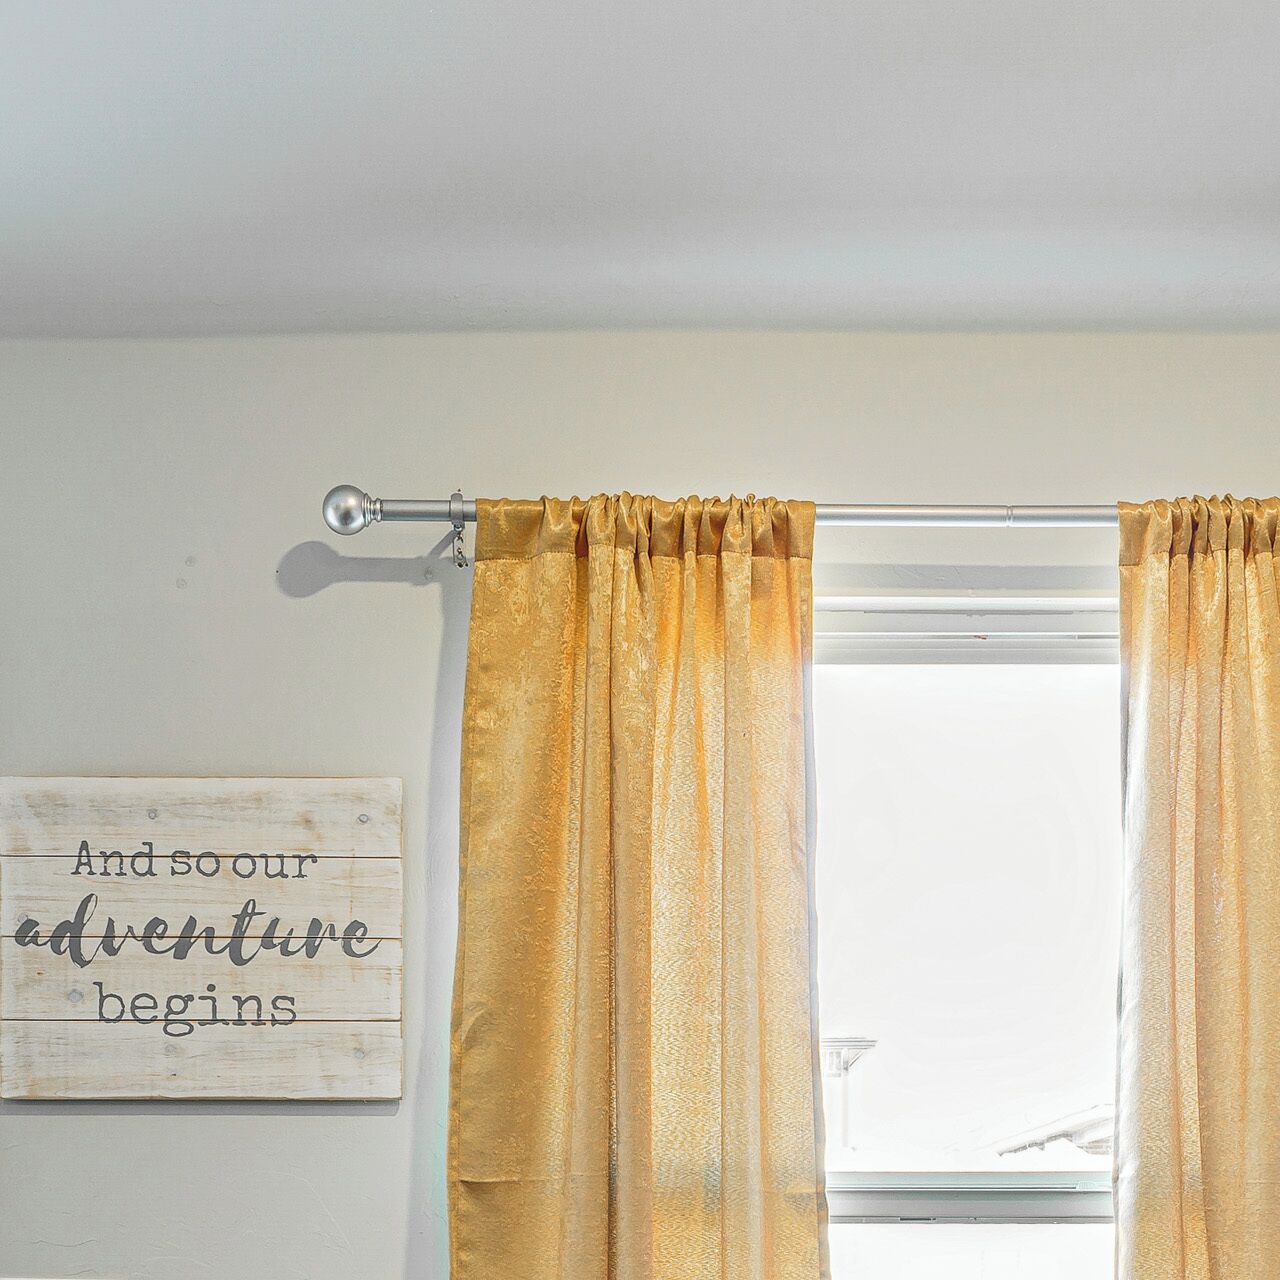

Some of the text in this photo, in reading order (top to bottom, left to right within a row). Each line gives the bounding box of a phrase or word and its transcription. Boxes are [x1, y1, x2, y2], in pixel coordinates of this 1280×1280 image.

[70, 840, 318, 879] And so our
[13, 893, 382, 968] adventure
[93, 981, 297, 1037] begins
